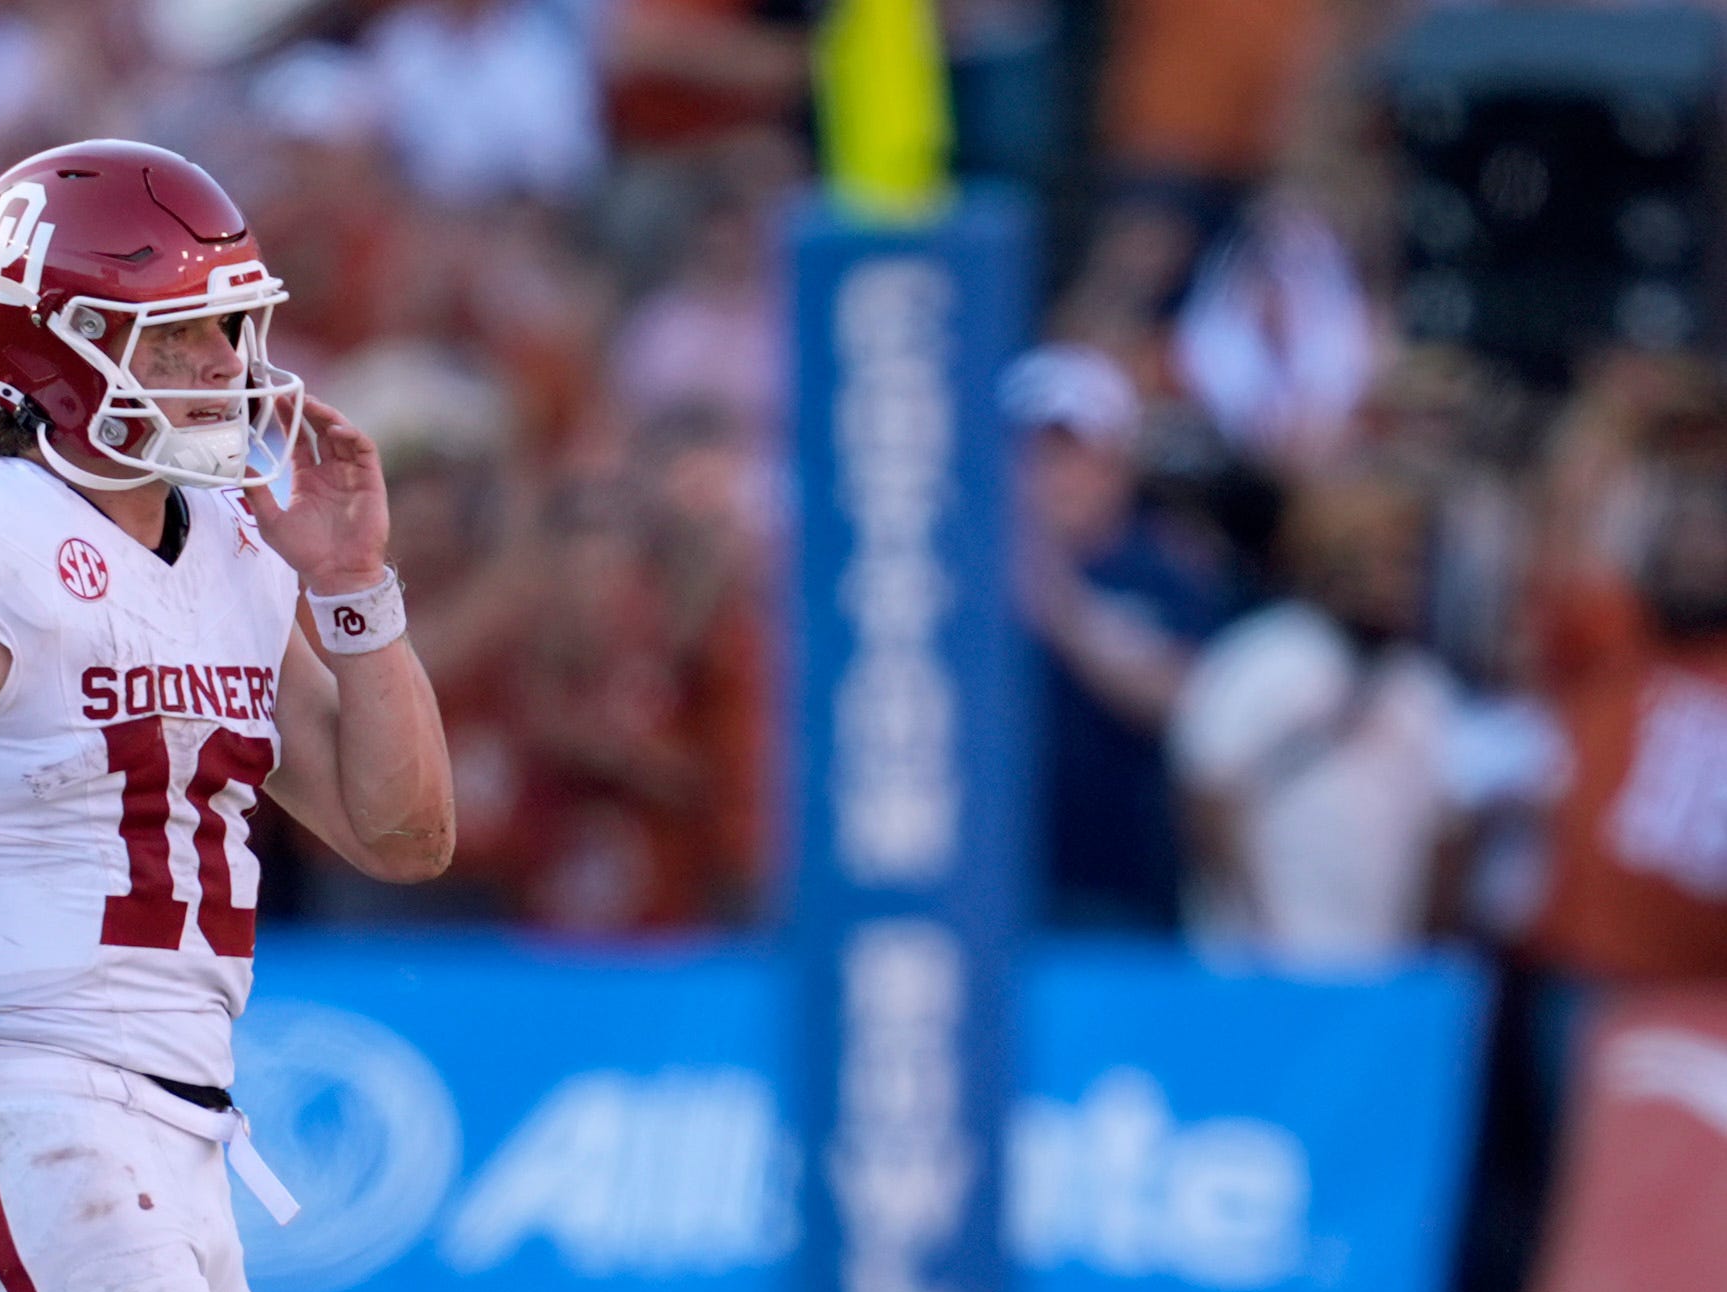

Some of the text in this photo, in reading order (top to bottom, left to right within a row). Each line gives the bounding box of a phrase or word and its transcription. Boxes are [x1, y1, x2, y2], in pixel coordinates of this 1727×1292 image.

[59, 540, 108, 598] SEC
[82, 663, 275, 722] SOONERS
[100, 714, 275, 958] 10
